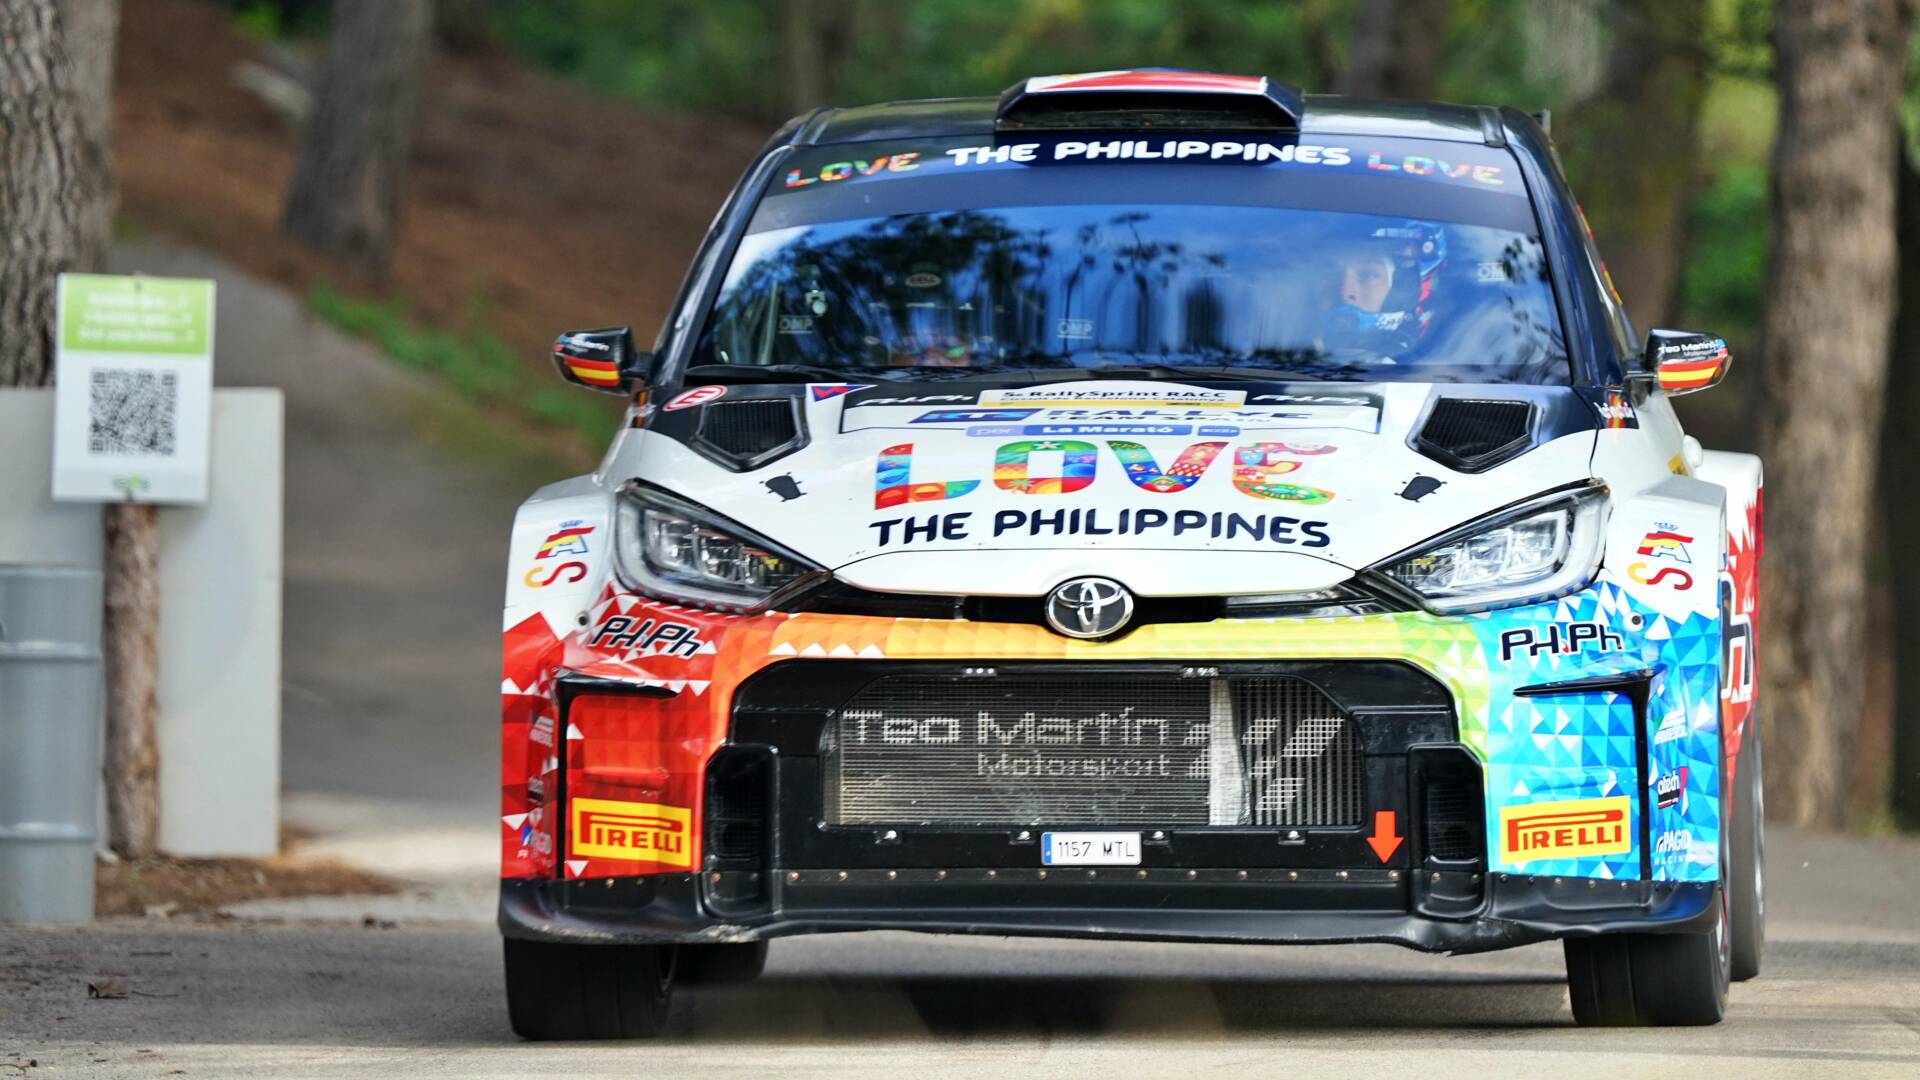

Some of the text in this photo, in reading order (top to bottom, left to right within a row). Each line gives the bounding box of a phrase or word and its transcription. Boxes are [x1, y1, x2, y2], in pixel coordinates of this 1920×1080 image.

[785, 152, 921, 188] LOVE
[945, 139, 1351, 167] THE PHILIPPINES
[1366, 150, 1505, 185] LOVE
[1166, 391, 1227, 399] RACC
[1042, 426, 1073, 434] La
[1077, 425, 1174, 434] Marató
[1046, 409, 1313, 420] RALLYE
[873, 440, 1339, 511] LOVE
[867, 507, 1331, 548] THE PHILIPPINES
[843, 706, 1170, 746] Teo Martín
[579, 810, 684, 854] PIRELLI
[1507, 808, 1625, 853] PIRELLI
[1058, 841, 1136, 857] 1157 MTL
